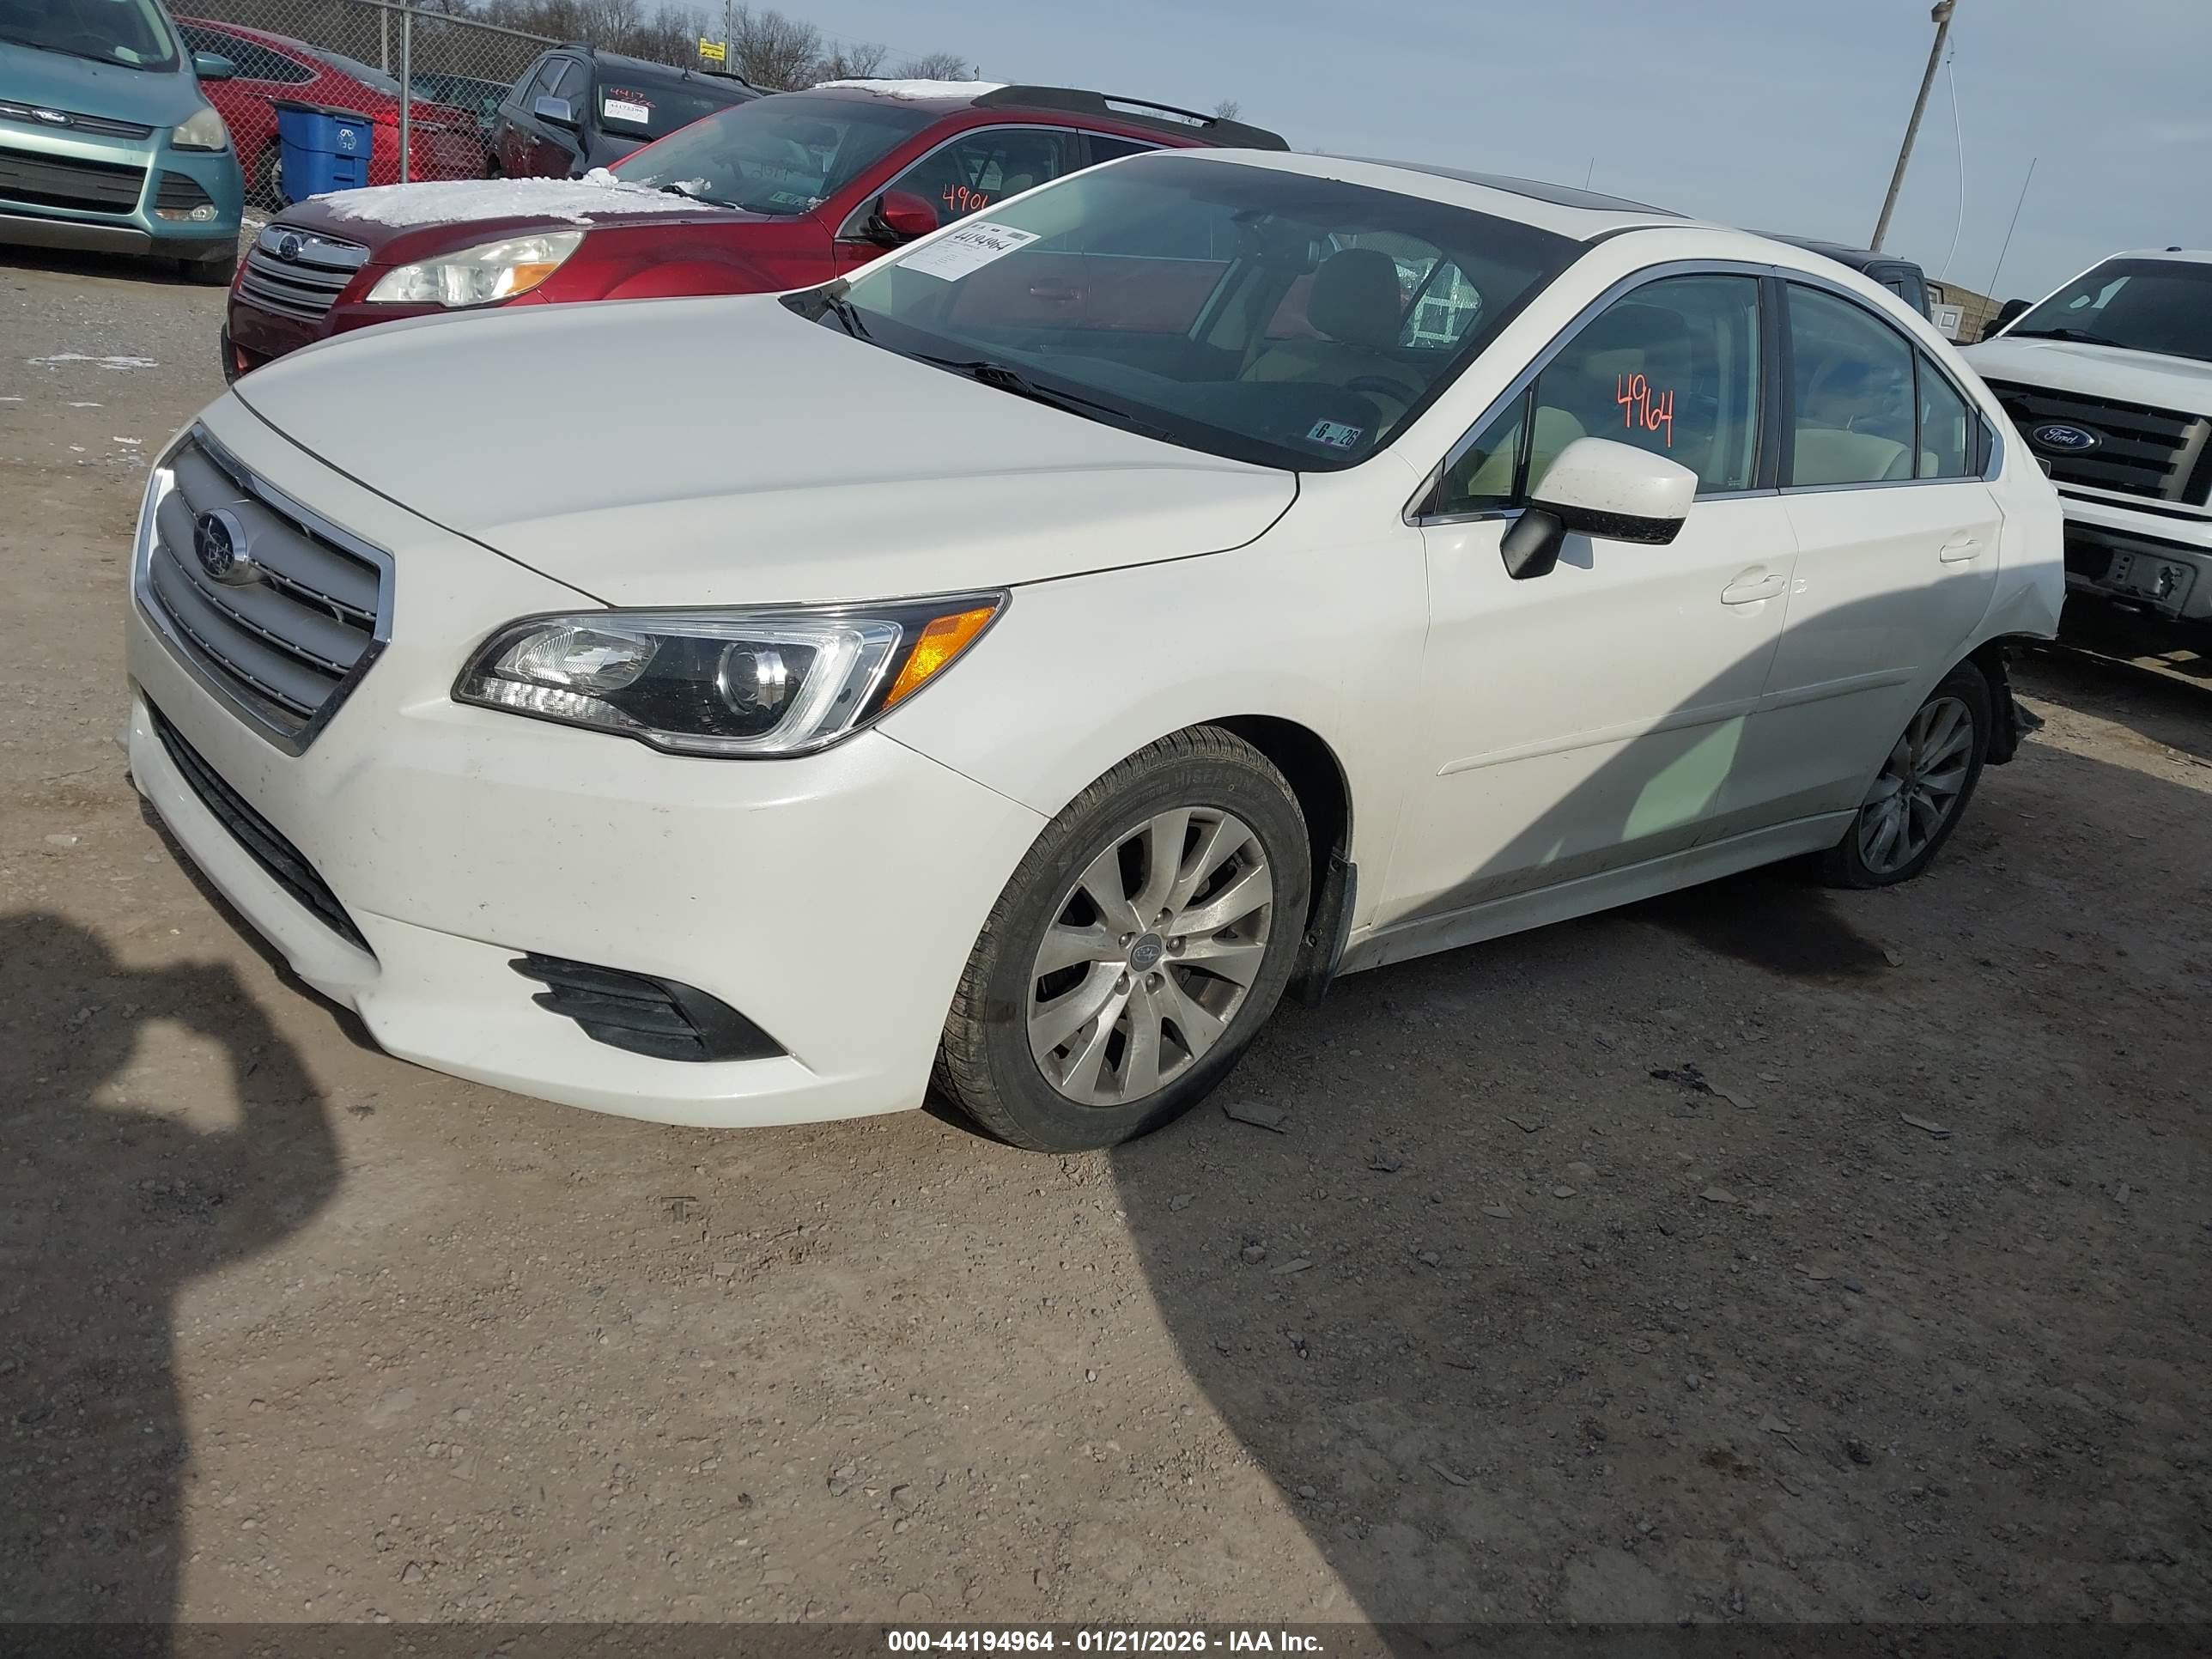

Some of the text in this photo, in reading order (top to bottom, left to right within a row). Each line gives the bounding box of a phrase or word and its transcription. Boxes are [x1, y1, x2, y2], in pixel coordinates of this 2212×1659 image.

[1617, 373, 1674, 447] 4964
[1316, 423, 1330, 439] 6
[2044, 428, 2078, 444] Ford
